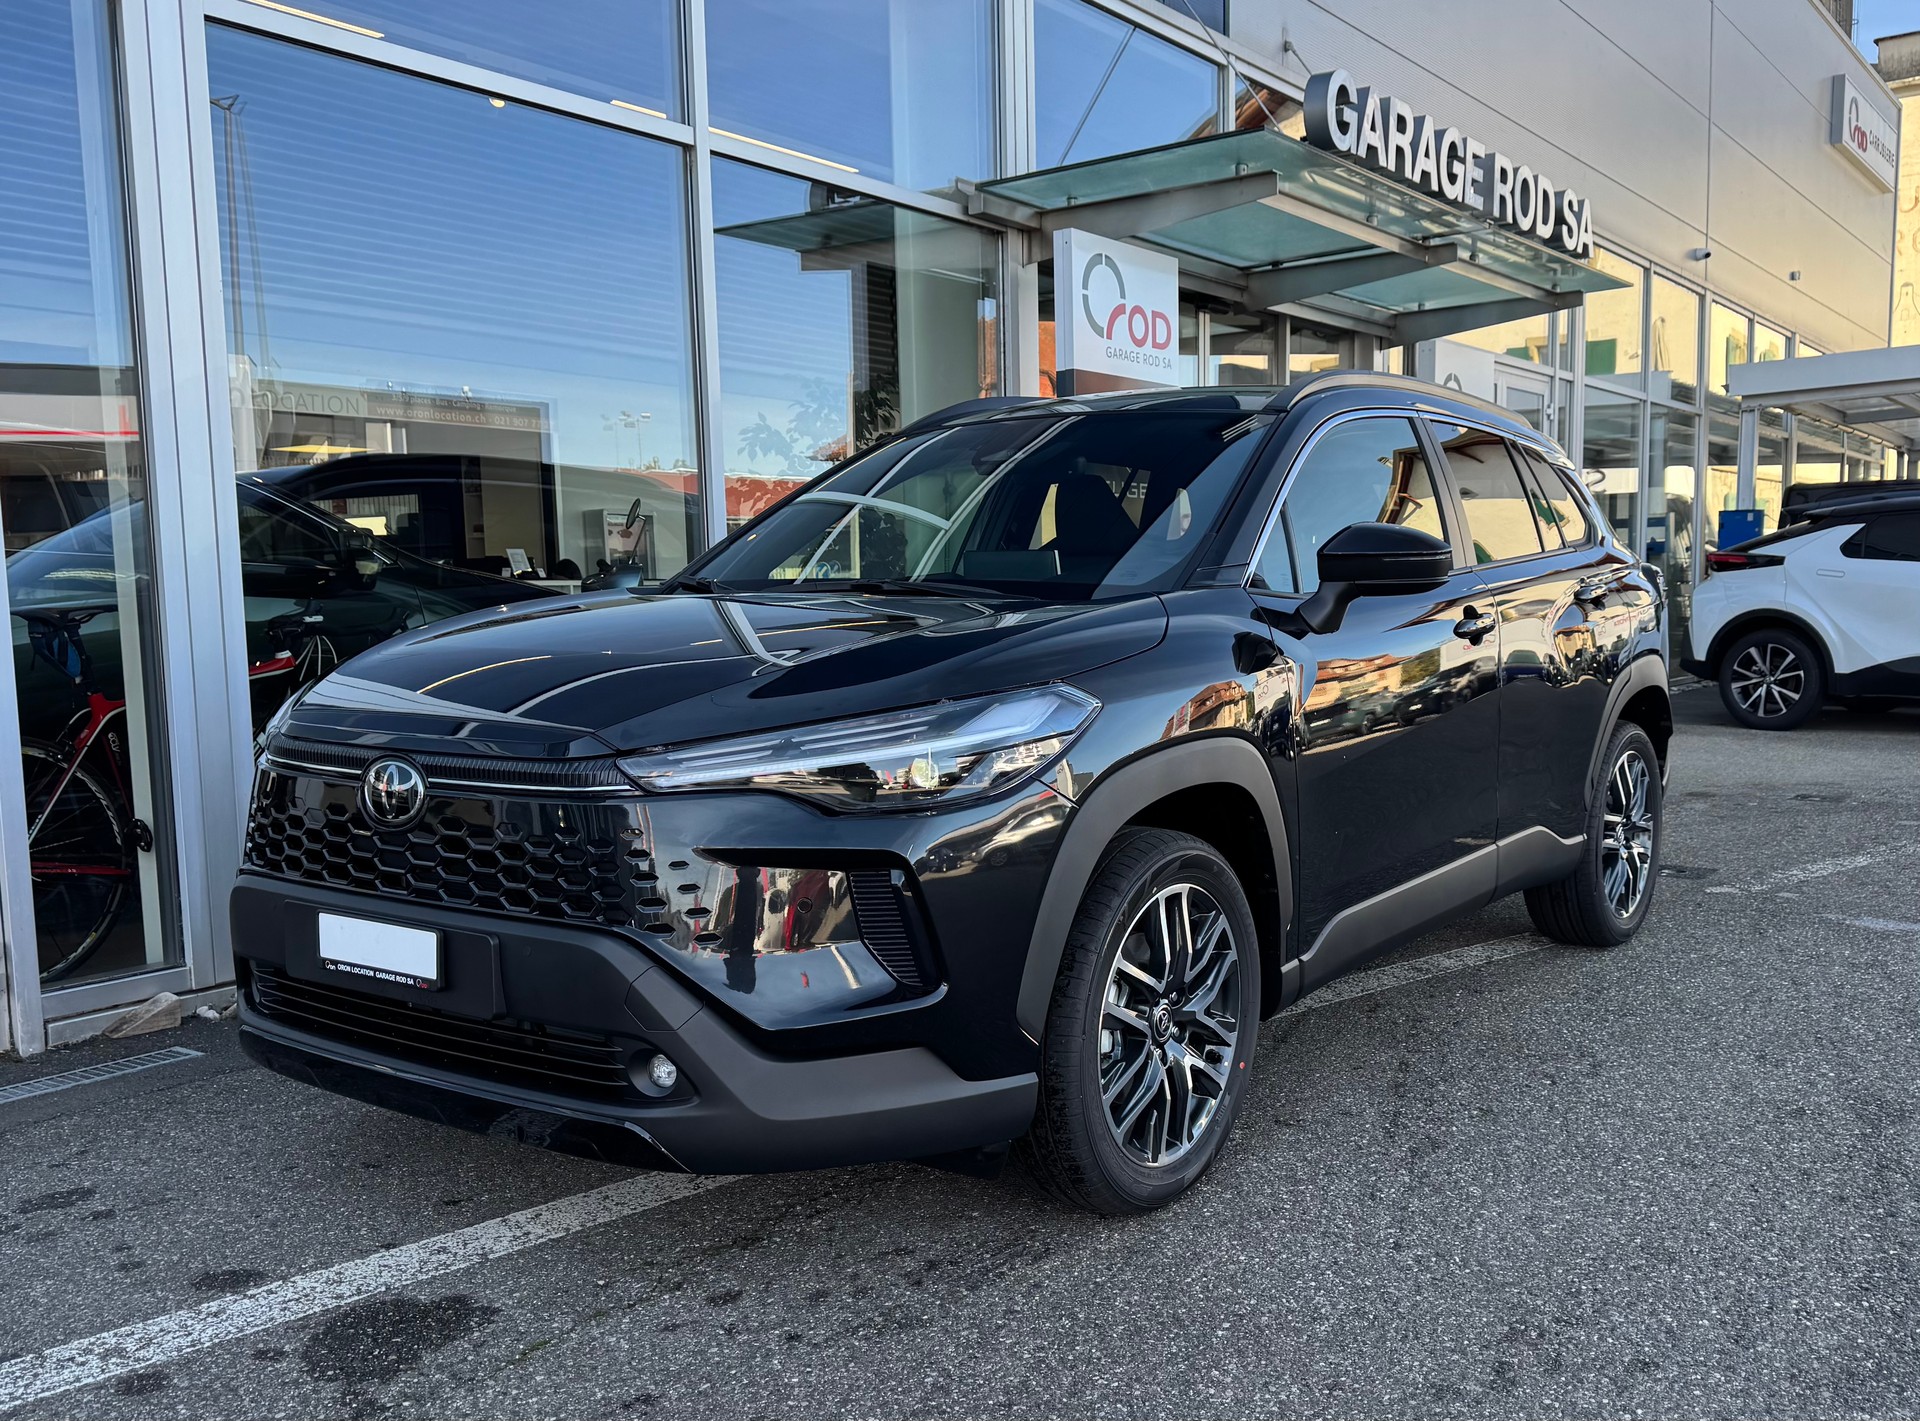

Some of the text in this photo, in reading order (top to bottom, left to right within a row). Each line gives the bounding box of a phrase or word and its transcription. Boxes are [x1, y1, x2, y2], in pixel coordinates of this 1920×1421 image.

[1326, 68, 1594, 258] GARAGE ROD SA
[1105, 345, 1172, 370] GARAGE ROD SA
[376, 405, 487, 424] www.oronlocation.ch
[494, 415, 510, 426] 021
[337, 963, 351, 972] ORON
[351, 966, 374, 977] LOCATION
[375, 971, 396, 982] GARAGE
[396, 975, 407, 984] ROD
